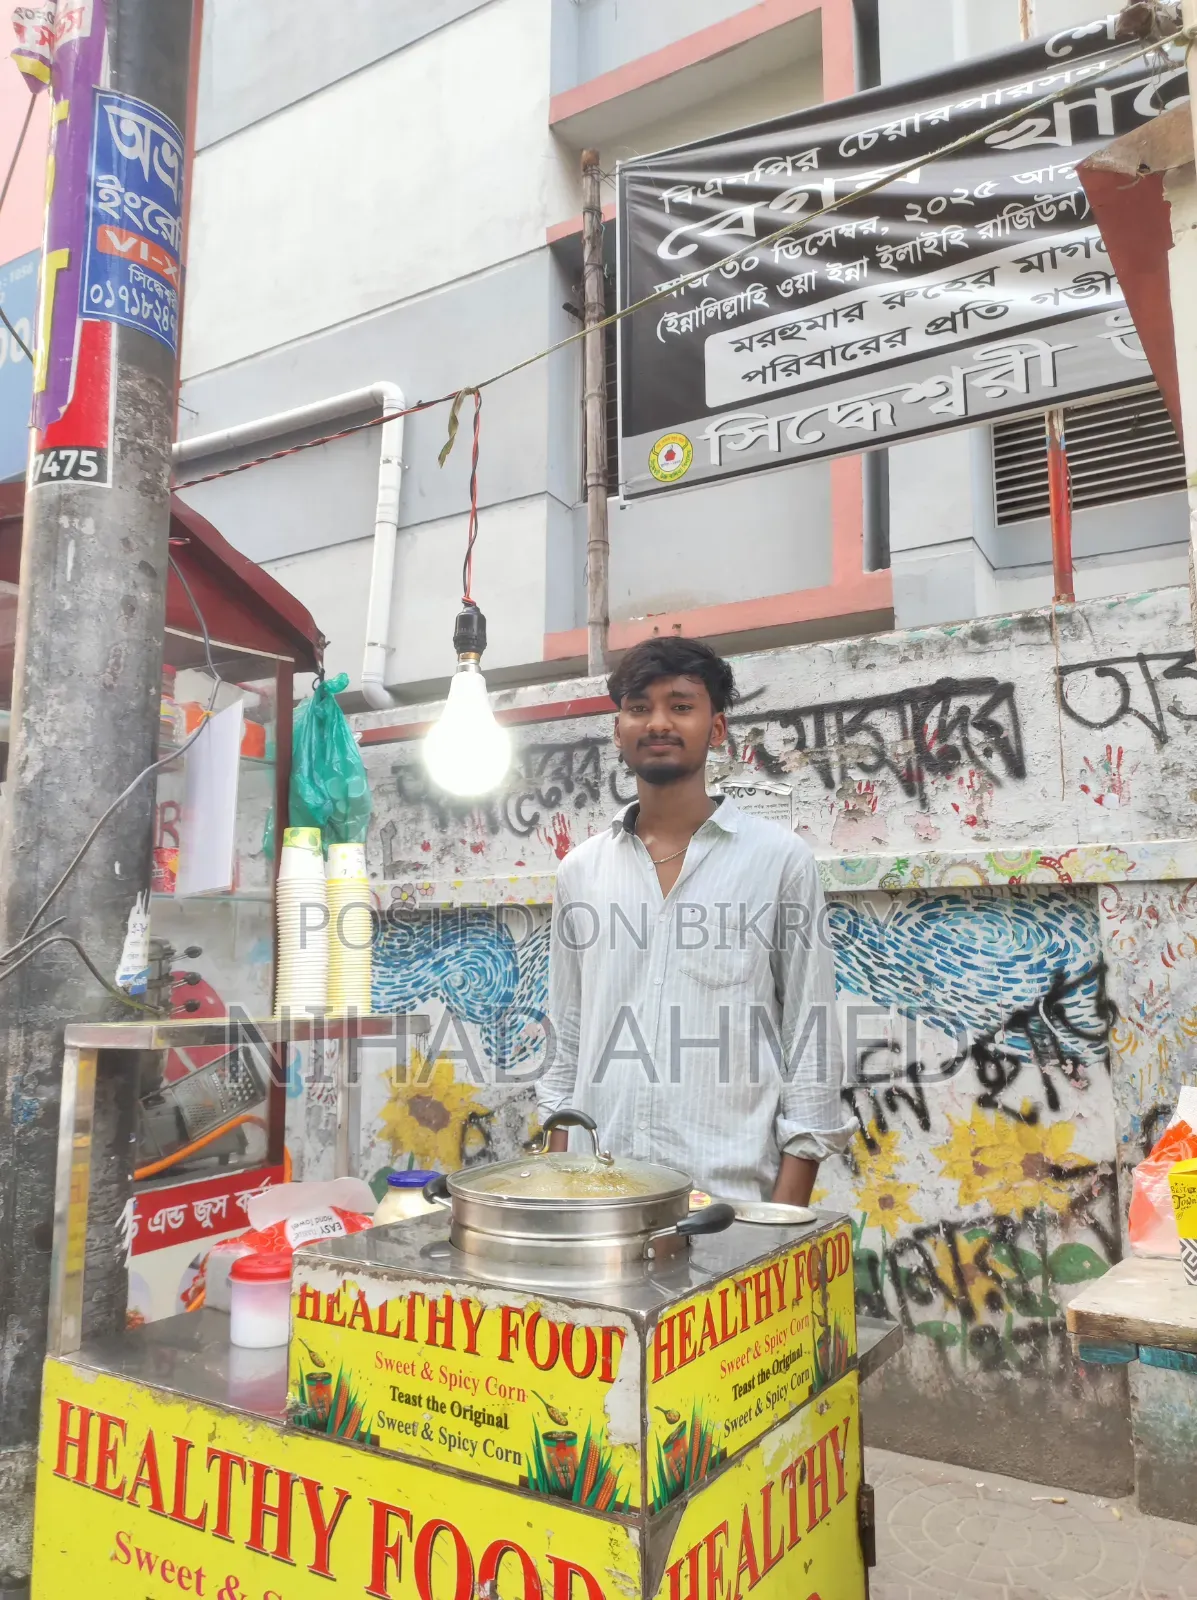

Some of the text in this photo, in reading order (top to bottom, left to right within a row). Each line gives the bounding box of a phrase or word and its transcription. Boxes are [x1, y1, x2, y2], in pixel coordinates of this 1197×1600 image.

[659, 147, 821, 214] বিএনপির
[719, 256, 760, 279] ৩০
[770, 215, 890, 265] ডিসেম্বর,
[904, 180, 1001, 223] ২০২৫
[776, 268, 818, 299] ওয়া
[825, 254, 870, 284] ইন্না
[875, 223, 970, 272] ইলাইহি
[974, 186, 1090, 241] রাজিউন)
[728, 300, 869, 353] মরহুমার
[878, 265, 1001, 310] রুহের
[741, 327, 913, 385] পরিবারের
[924, 298, 1015, 336] প্রতি
[696, 337, 1079, 467] সিদ্ধেশ্বরী
[320, 1221, 343, 1235] EASY
[296, 1279, 487, 1357] HEALTHY
[651, 1257, 789, 1385] HEALTHY
[793, 1231, 850, 1301] FOOD
[375, 1351, 527, 1403] Sweet & Spicy Corn
[720, 1314, 810, 1380] Sweet & Spicy Corn
[732, 1342, 803, 1402] Teast the Original
[377, 1410, 522, 1466] Sweet & Spicy Corn
[389, 1385, 510, 1430] Teast the Original
[723, 1368, 810, 1439] Sweet & Spicy Corn
[52, 1397, 351, 1581] HEALTHY
[112, 1530, 207, 1597] Sweet
